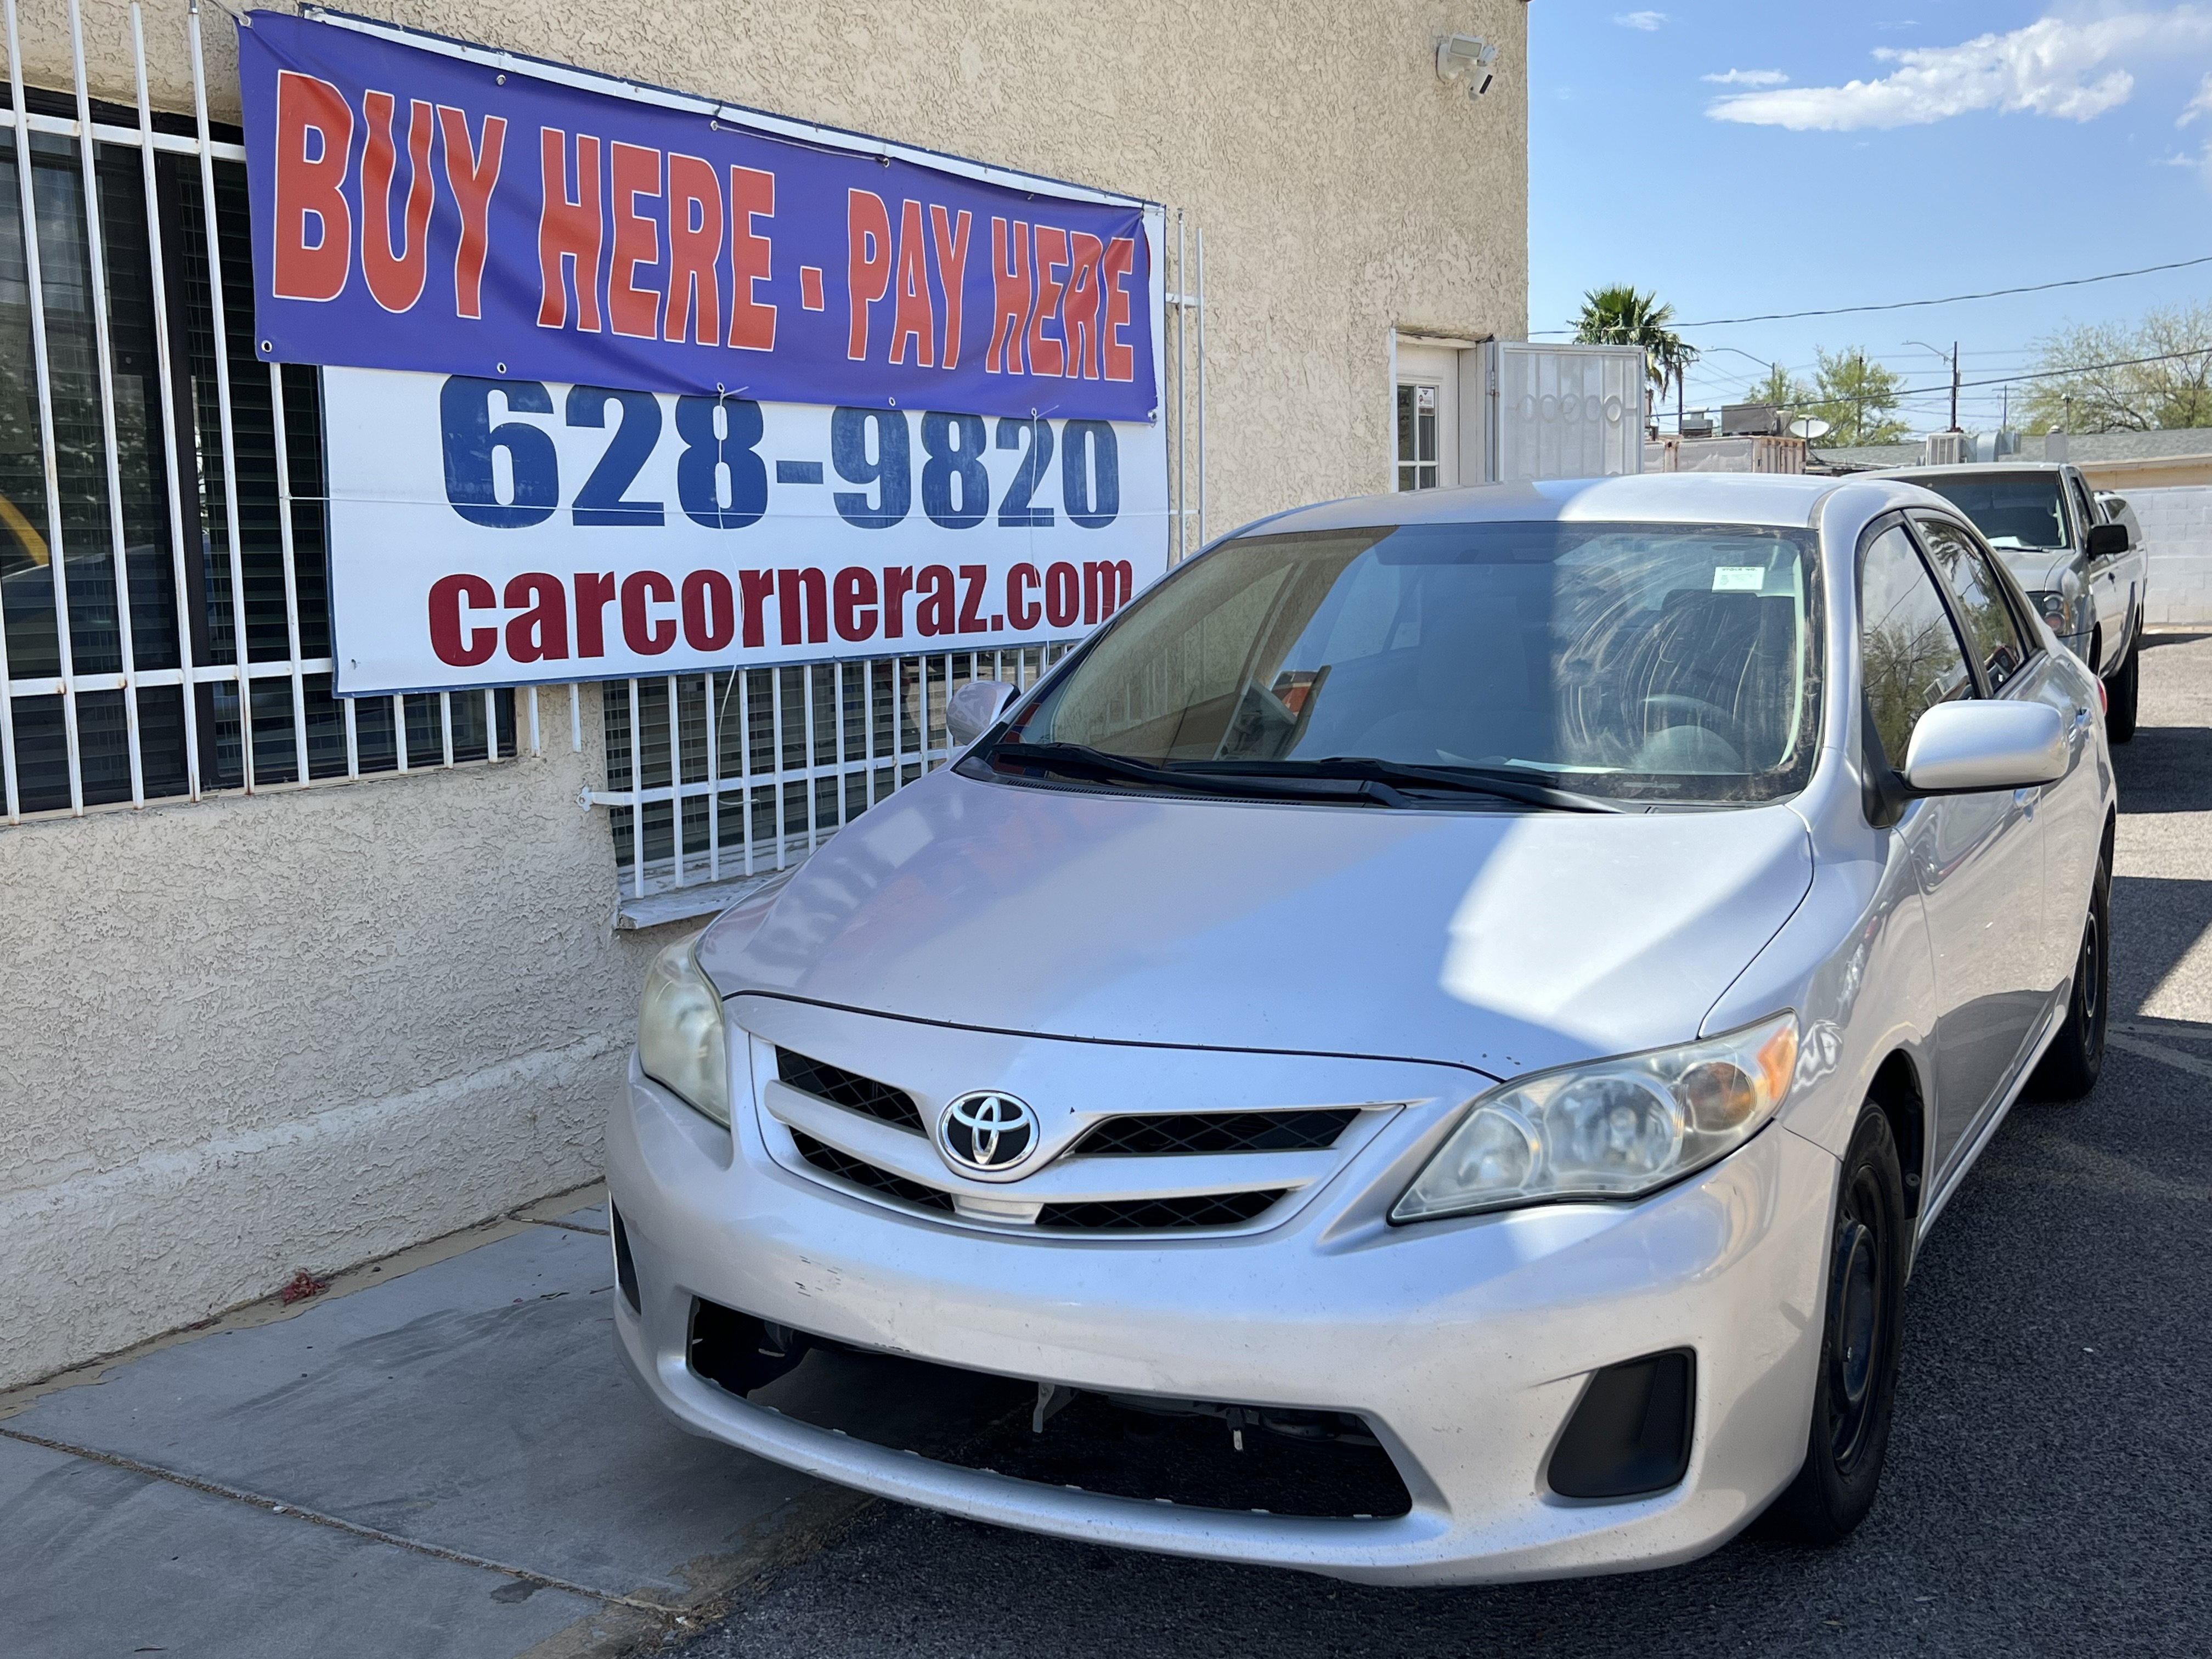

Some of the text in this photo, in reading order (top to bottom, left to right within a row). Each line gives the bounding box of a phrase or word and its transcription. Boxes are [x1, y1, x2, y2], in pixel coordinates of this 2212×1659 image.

[273, 69, 507, 319] BUY
[536, 126, 777, 352] HERE
[847, 188, 972, 370] PAY
[986, 216, 1135, 382] HERE
[439, 374, 1120, 529] 628-9820
[428, 559, 1133, 667] carcorneraz.com
